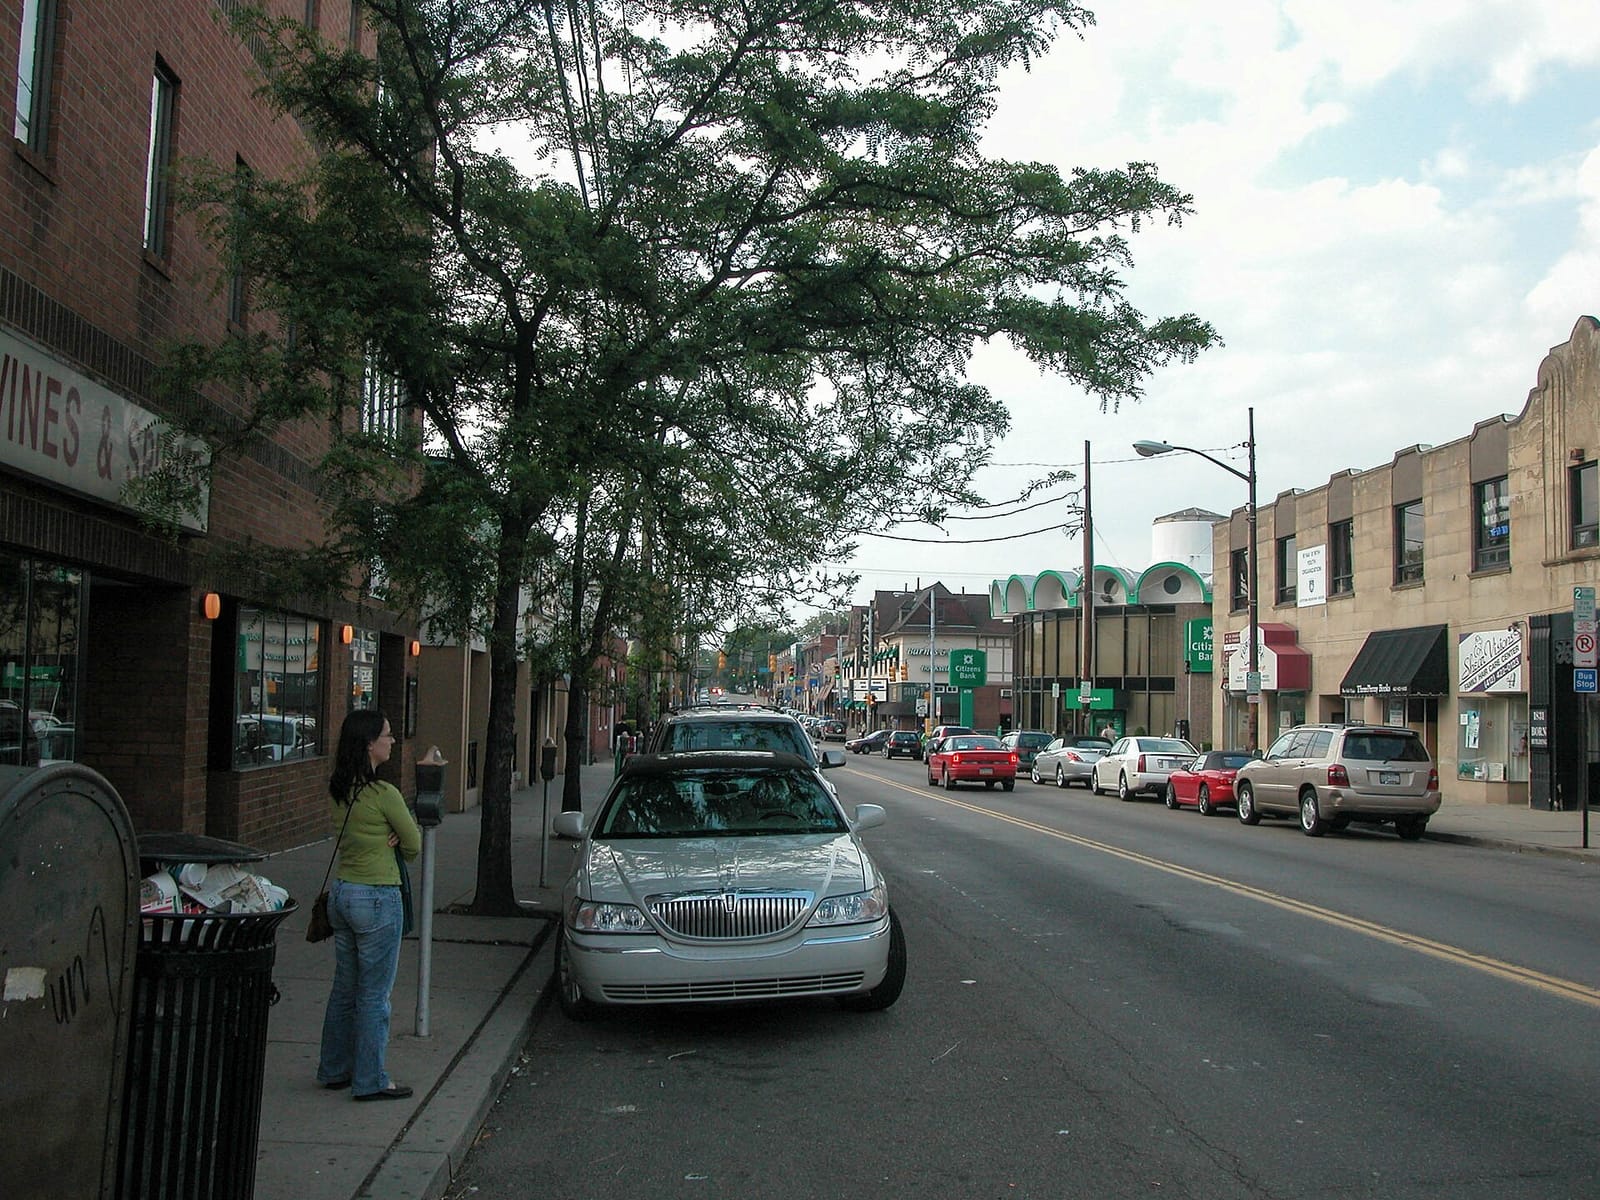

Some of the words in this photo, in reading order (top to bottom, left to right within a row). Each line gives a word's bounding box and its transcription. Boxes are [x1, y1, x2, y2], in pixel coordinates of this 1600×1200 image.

[97, 405, 113, 481] &
[1574, 588, 1581, 599] 2
[1191, 642, 1213, 652] Citiz
[1464, 676, 1478, 690] FAMILY
[1478, 668, 1489, 681] HAIR
[1489, 658, 1501, 673] CARE
[1501, 645, 1520, 663] CENTER
[1578, 672, 1593, 680] Bus
